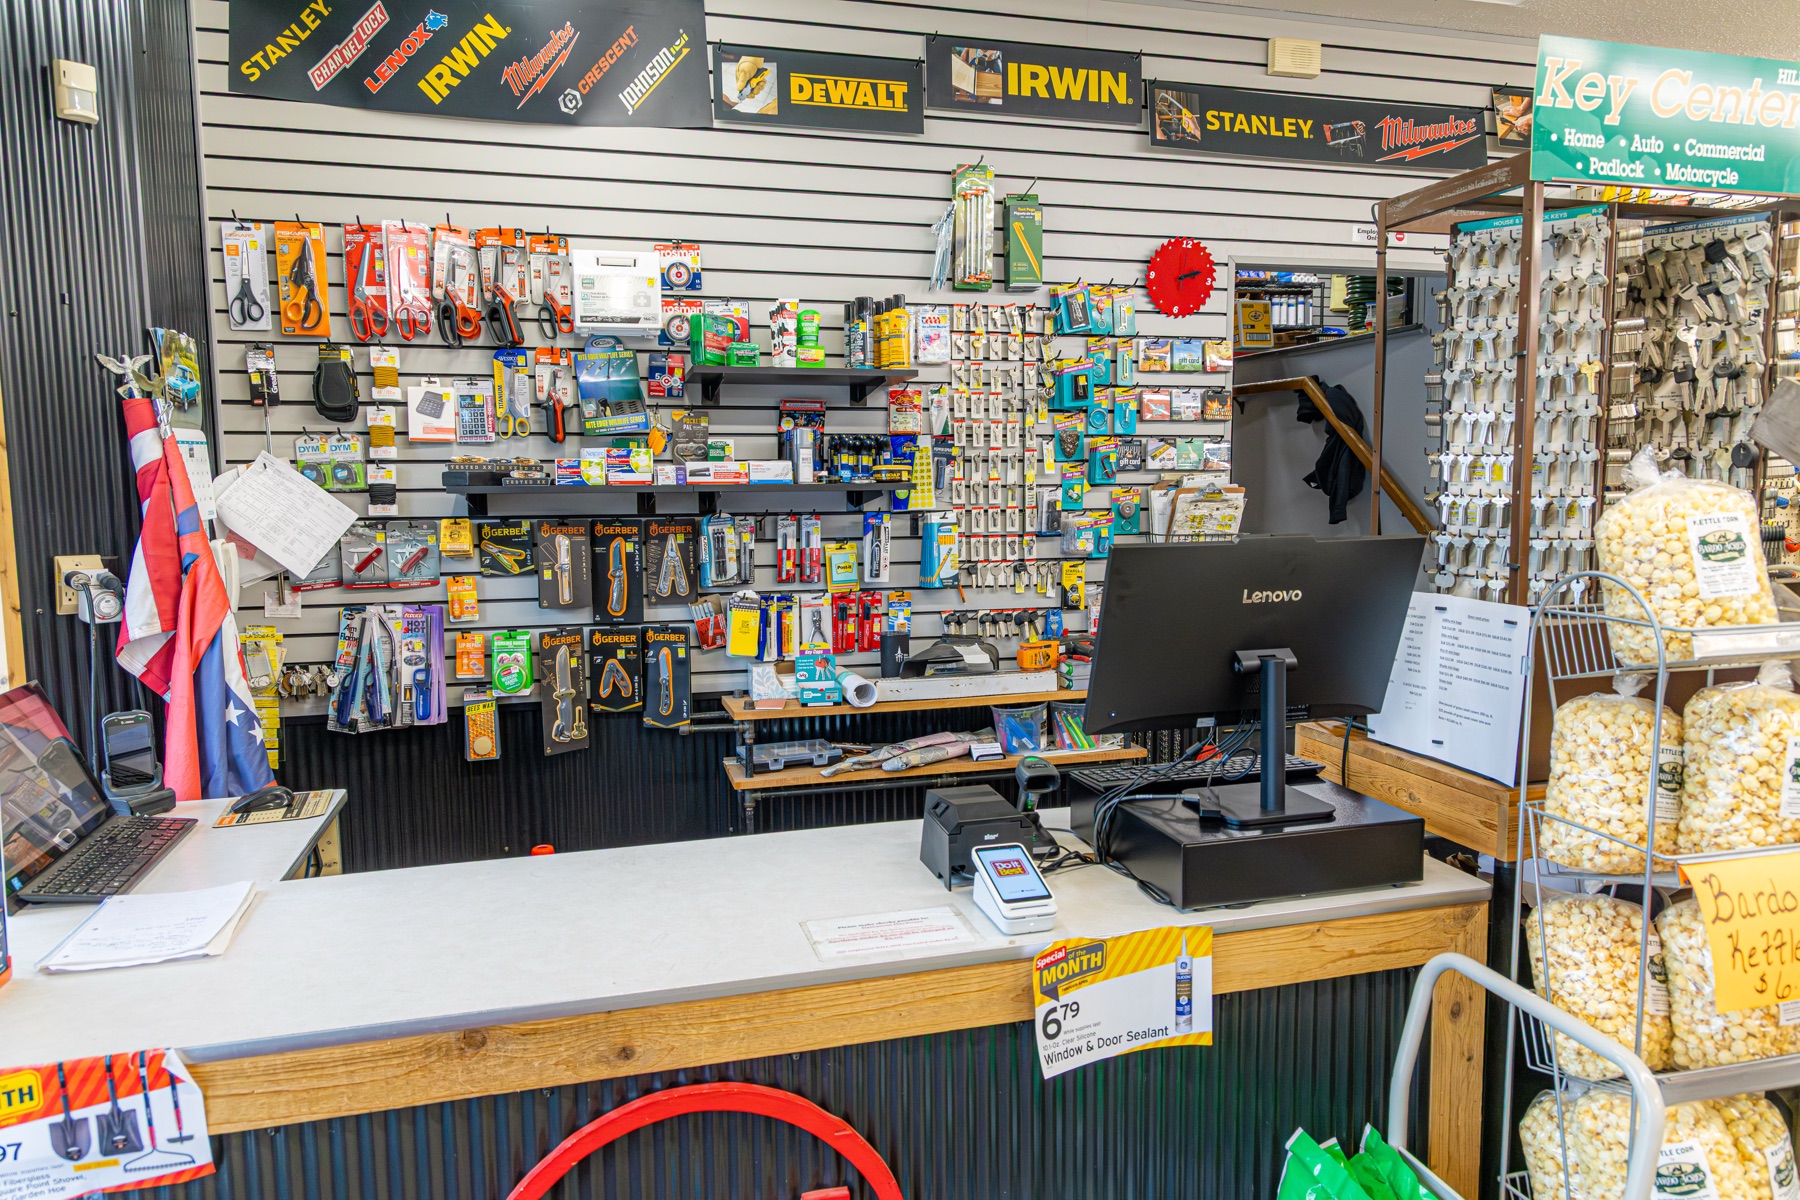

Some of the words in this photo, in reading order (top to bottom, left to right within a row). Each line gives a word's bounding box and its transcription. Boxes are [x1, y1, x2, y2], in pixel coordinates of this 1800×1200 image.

[241, 0, 331, 82] STANLEY
[364, 23, 432, 94] LENOX
[417, 13, 508, 105] IRWIN
[501, 21, 575, 97] Milwaukee
[578, 25, 638, 95] CRESCENT
[618, 46, 672, 116] JOHNSON
[1008, 62, 1130, 105] IRWIN
[1536, 56, 1638, 126] Key
[1651, 68, 1800, 129] Center
[1206, 110, 1314, 139] STANLEY
[1375, 115, 1477, 151] Milwaukee
[1563, 128, 1605, 149] Home
[1630, 135, 1664, 154] Auto
[1684, 138, 1765, 162] Commercial
[1589, 157, 1644, 178] Padlock
[1665, 163, 1739, 187] Motorcycle
[1551, 212, 1568, 221] KEYS
[1494, 218, 1515, 227] HOUSE
[1674, 223, 1697, 233] IMPORT
[1698, 219, 1737, 229] AUTOMOTIVE
[1738, 216, 1756, 225] KEYS
[1182, 240, 1193, 248] 12
[1149, 271, 1156, 279] 9
[1205, 278, 1212, 286] 3
[1172, 305, 1179, 314] 6
[1178, 357, 1187, 365] gift
[1188, 356, 1200, 364] card
[597, 420, 609, 428] EDGE
[629, 415, 646, 424] SERIES
[298, 446, 320, 454] DYM
[330, 444, 351, 453] DYM
[1119, 457, 1129, 467] gift
[1129, 457, 1141, 466] card
[491, 527, 527, 537] GERBER
[550, 526, 585, 535] GERBER
[604, 526, 639, 534] GERBER
[658, 525, 693, 534] GERBER
[1242, 588, 1303, 604] Lenovo
[343, 624, 357, 632] Aim
[550, 635, 581, 646] GERBER
[602, 635, 637, 643] GERBER
[654, 633, 685, 642] GERBER
[482, 701, 494, 710] WAX
[999, 867, 1025, 877] Best
[1701, 873, 1798, 924] Bardo
[1036, 948, 1066, 969] Special
[1068, 951, 1076, 960] of
[1076, 949, 1086, 958] the
[1042, 951, 1102, 987] MONTH
[1042, 1006, 1062, 1041] 6
[1060, 1001, 1080, 1021] 79
[1075, 1024, 1092, 1035] supplies
[1062, 1036, 1075, 1046] Clear
[1076, 1031, 1097, 1042] Silicone
[1043, 1043, 1083, 1066] Window
[1086, 1040, 1094, 1052] &
[1097, 1033, 1123, 1050] Door
[1126, 1025, 1169, 1042] Sealant
[3, 1174, 51, 1187] Fiberglass
[27, 1180, 50, 1191] Point
[48, 1185, 66, 1195] Hoe
